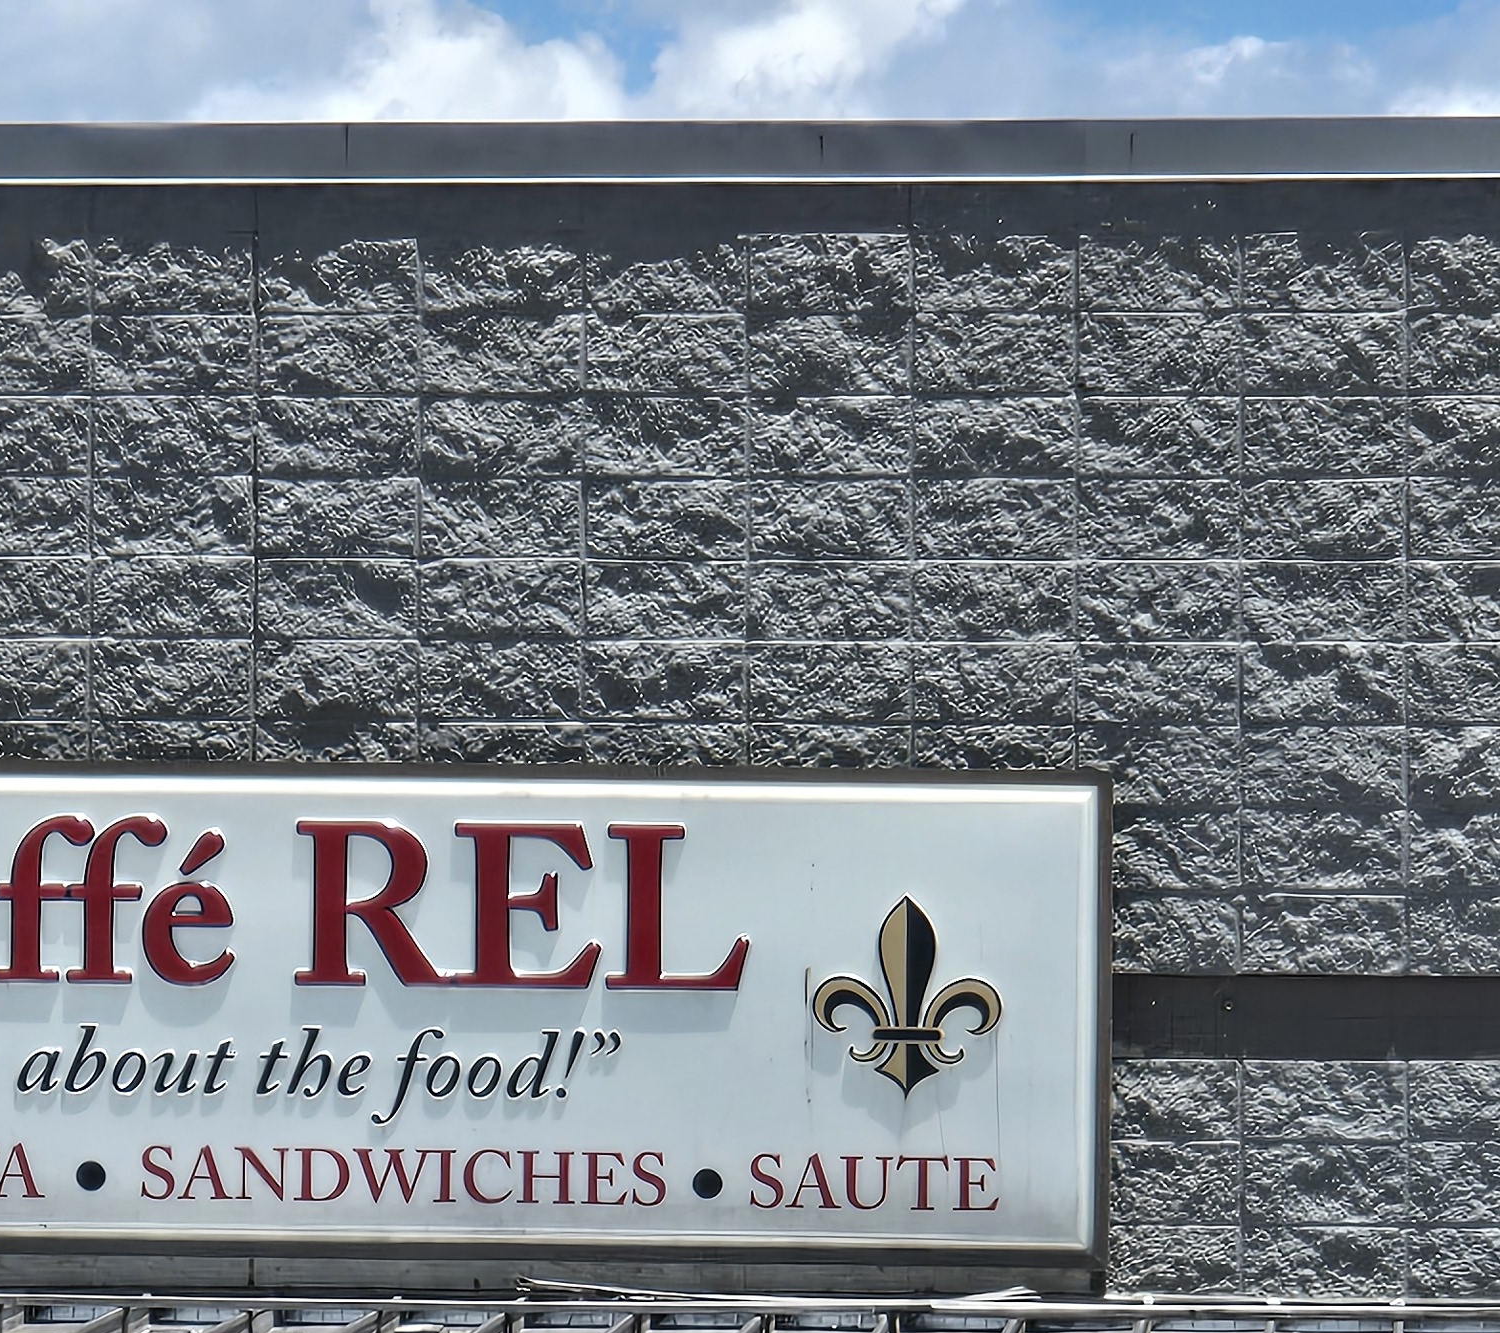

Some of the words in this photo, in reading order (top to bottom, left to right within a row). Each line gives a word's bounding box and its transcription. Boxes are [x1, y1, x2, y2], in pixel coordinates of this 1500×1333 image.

[294, 817, 751, 991] REL
[15, 1023, 241, 1096] about
[255, 1025, 372, 1098] the
[139, 1144, 668, 1208] SANDWICHES
[748, 1152, 1001, 1213] SAUTE
